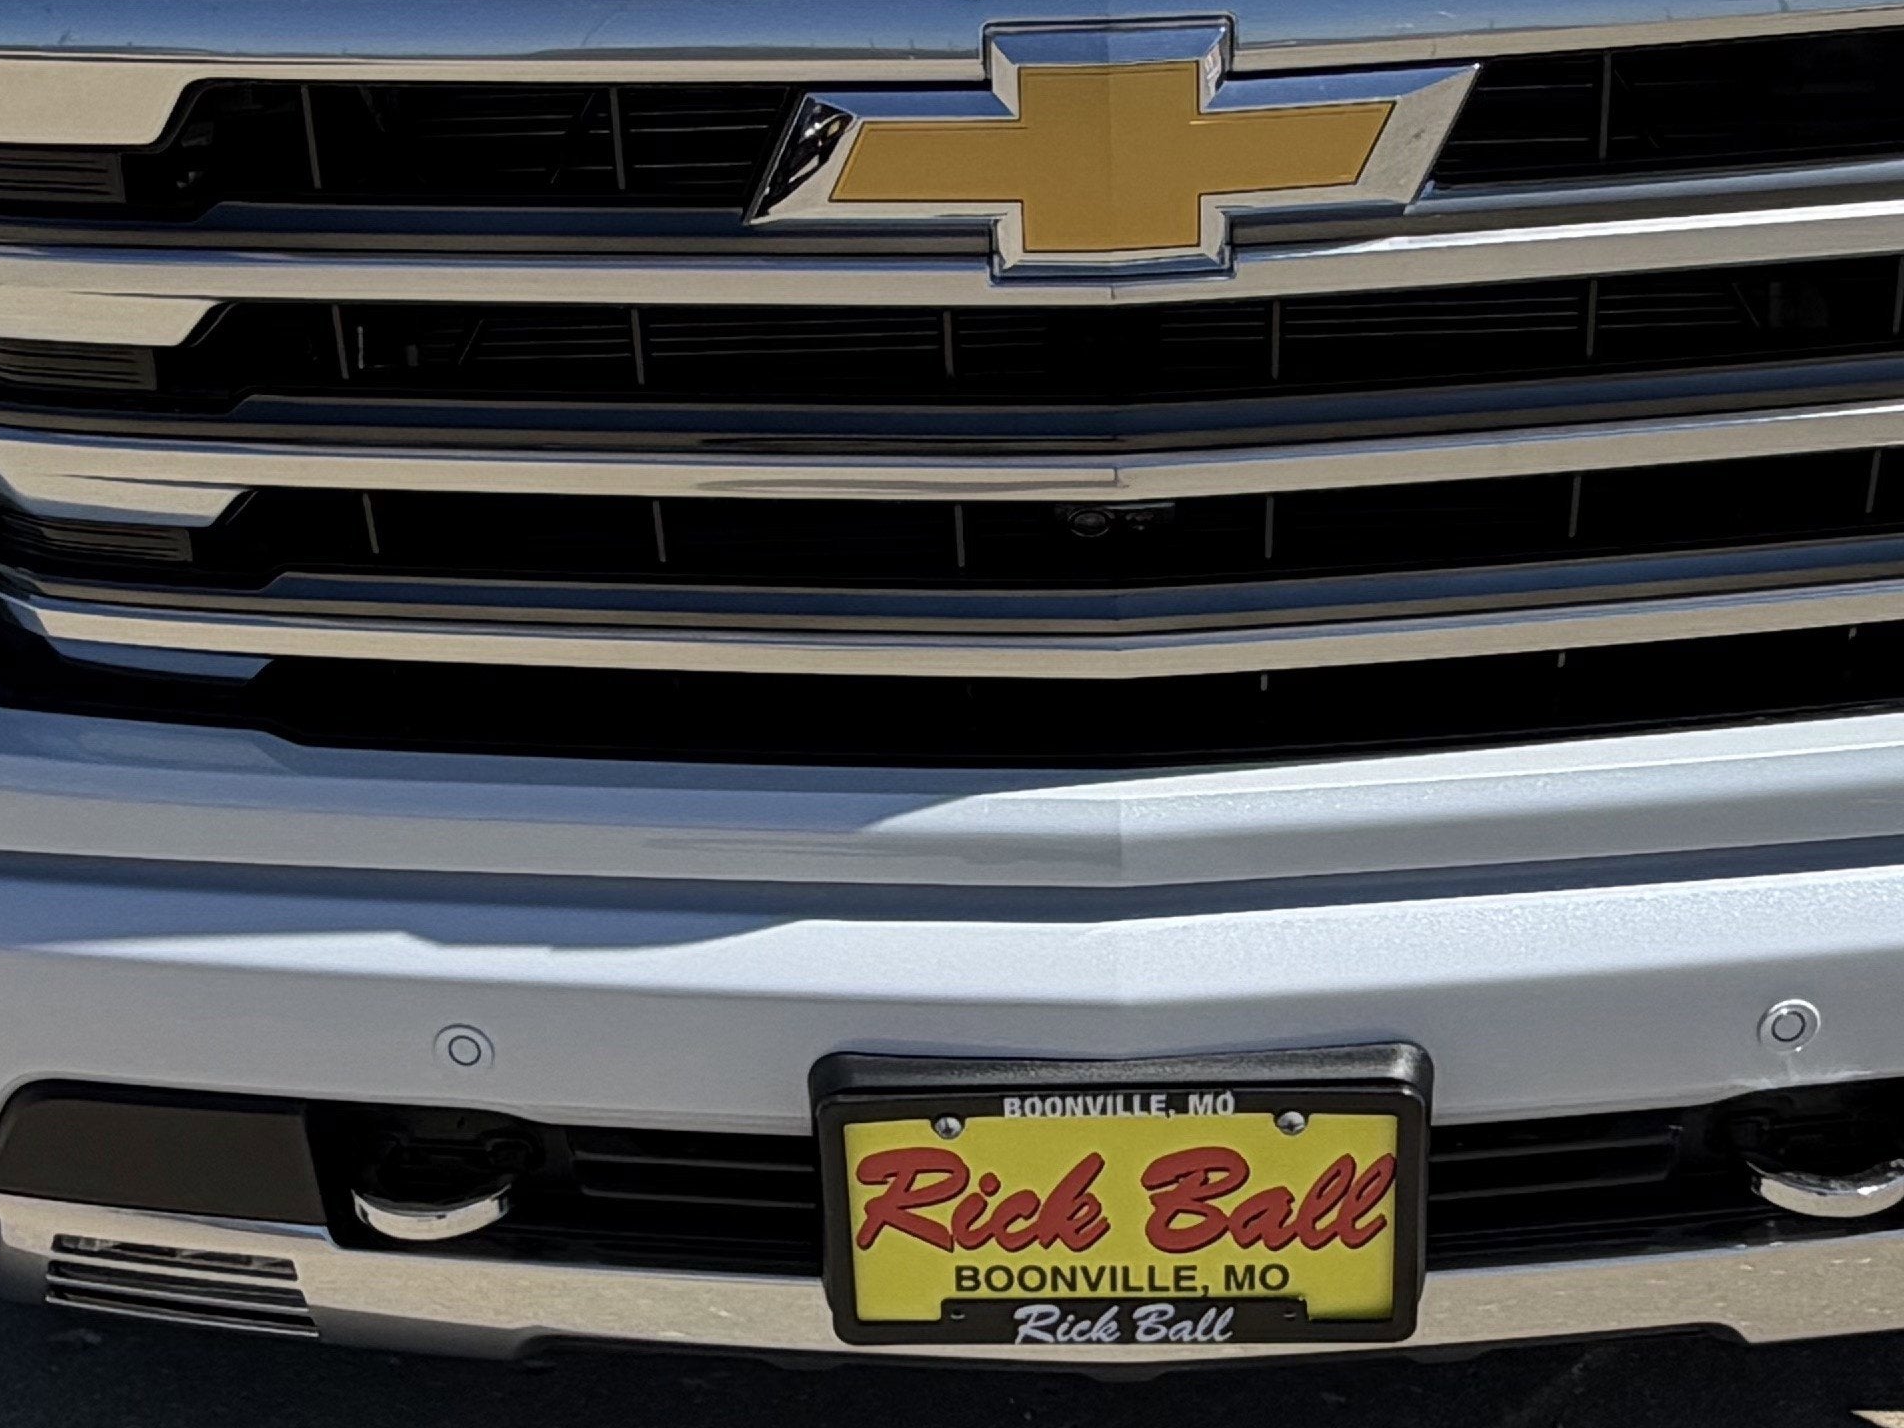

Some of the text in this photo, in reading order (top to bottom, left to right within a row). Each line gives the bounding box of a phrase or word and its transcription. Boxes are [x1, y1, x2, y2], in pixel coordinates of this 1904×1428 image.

[1003, 1091, 1235, 1122] BOONVILLE, MO
[855, 1145, 1397, 1254] Rick Ball
[954, 1263, 1290, 1297] BOONVILLE, MO
[1013, 1303, 1235, 1345] Rick Ball
